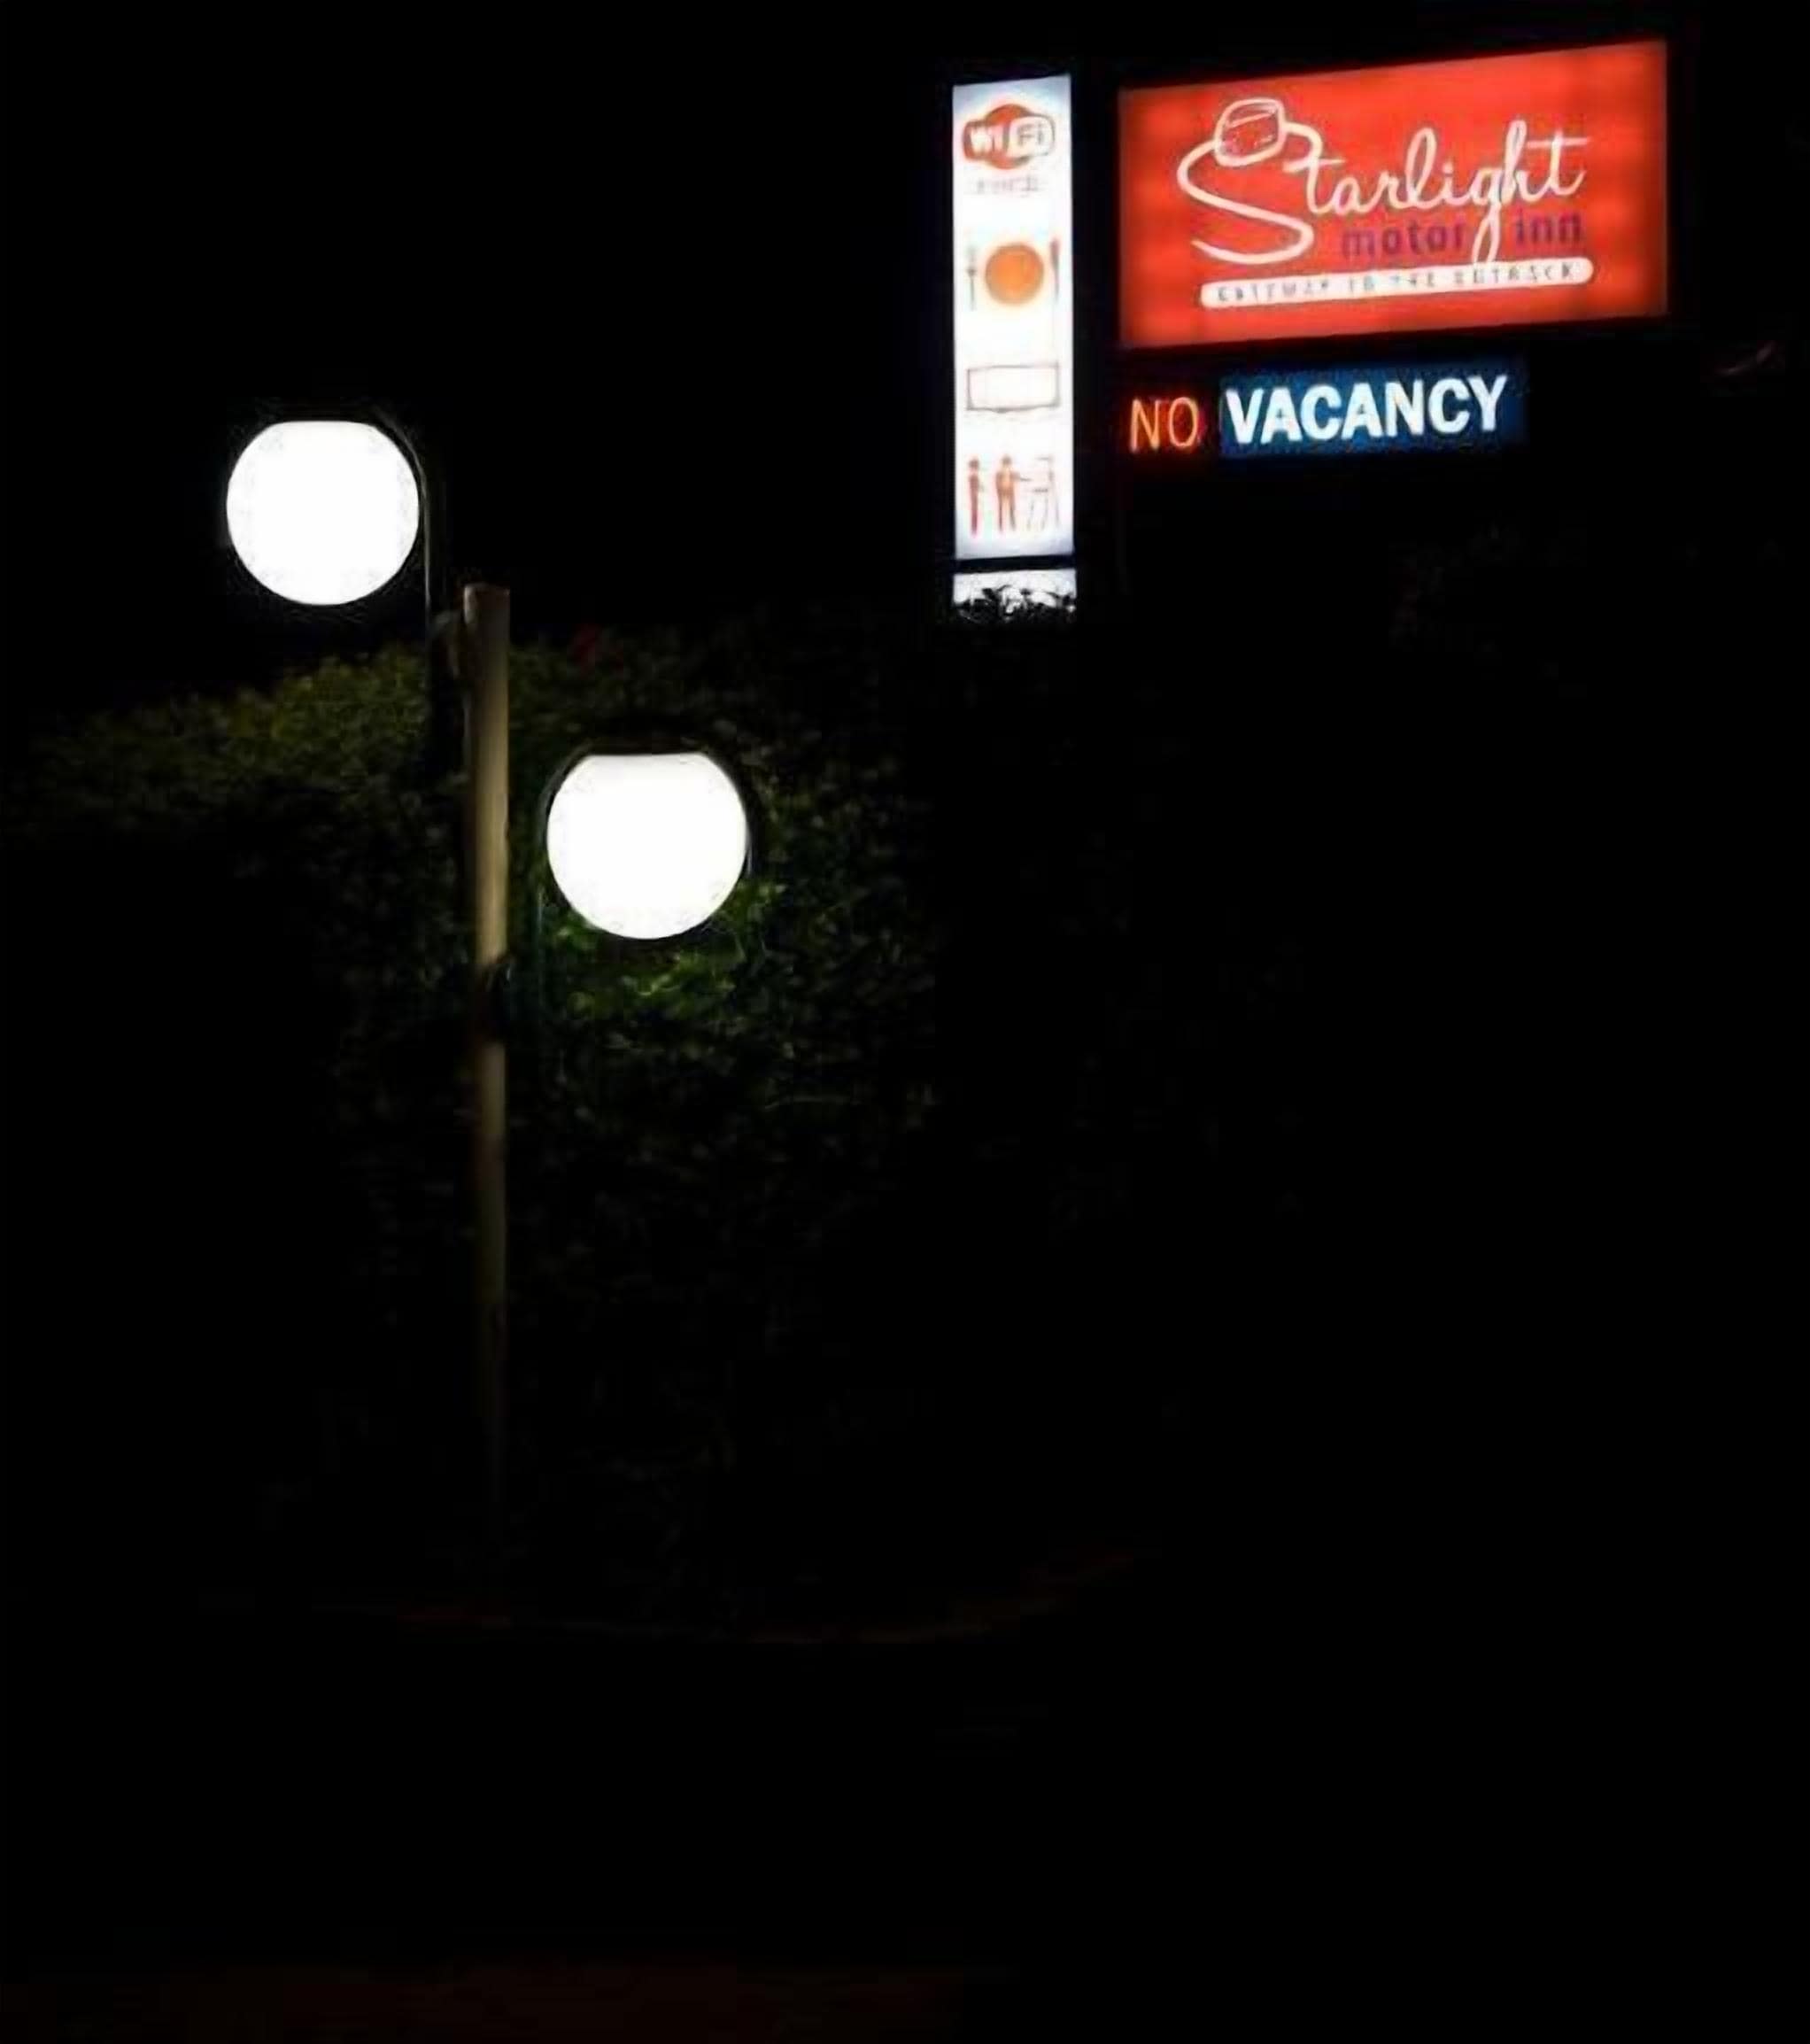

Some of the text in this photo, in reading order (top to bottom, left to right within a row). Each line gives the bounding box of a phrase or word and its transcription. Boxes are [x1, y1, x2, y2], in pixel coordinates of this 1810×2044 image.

[1178, 99, 1590, 266] Starlight
[1341, 207, 1583, 259] motor inn
[1129, 375, 1508, 453] NO VACANCY
